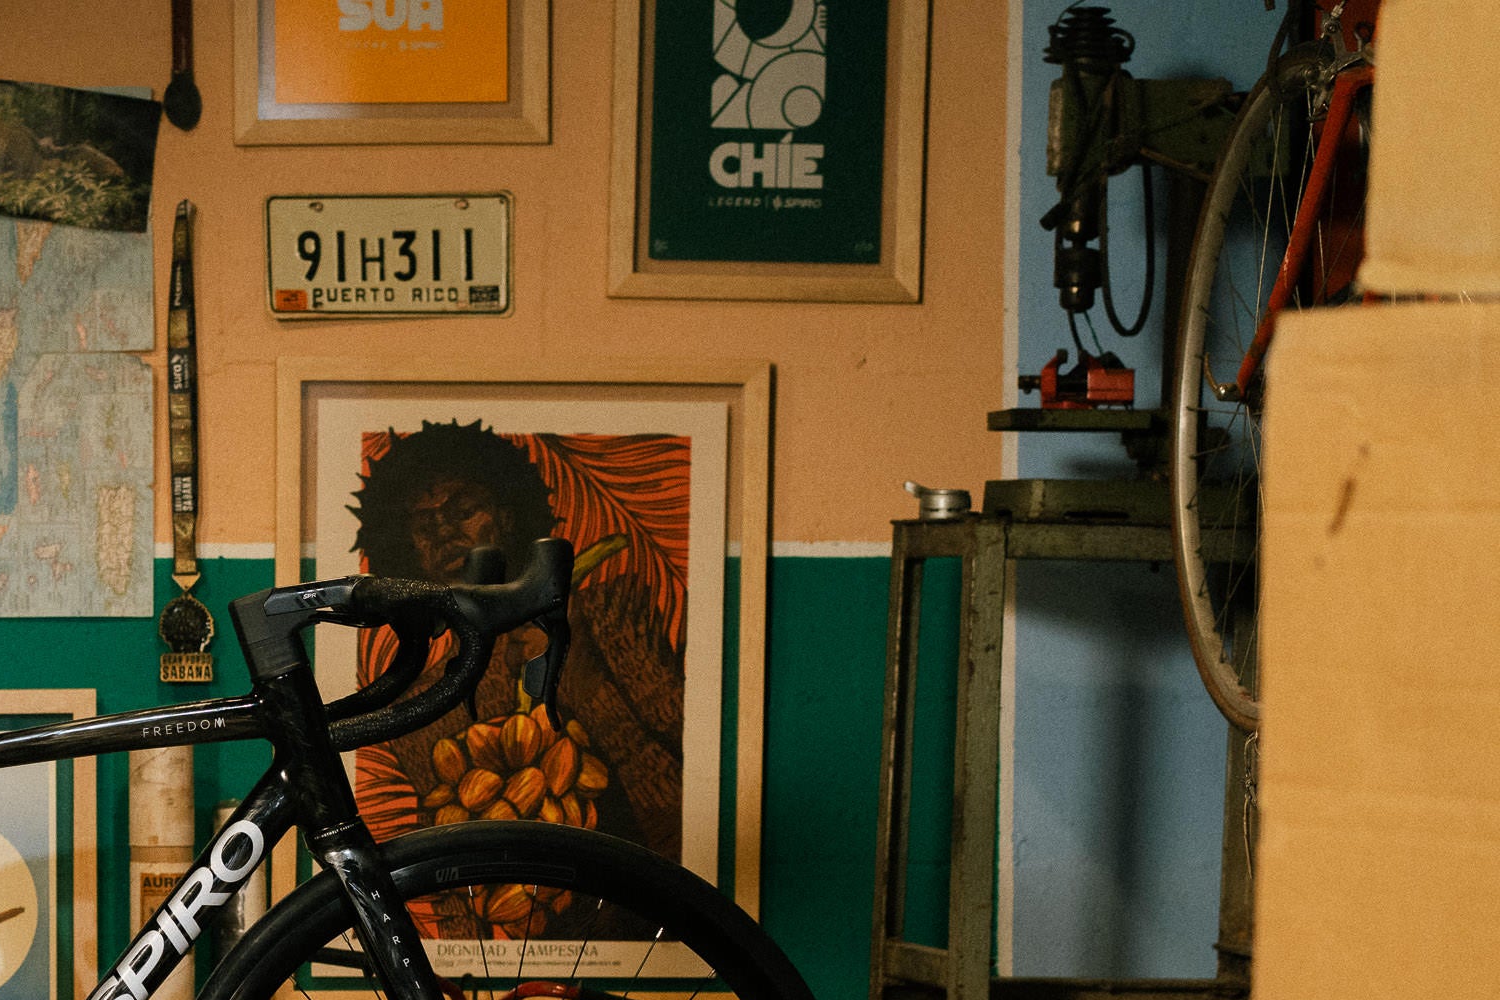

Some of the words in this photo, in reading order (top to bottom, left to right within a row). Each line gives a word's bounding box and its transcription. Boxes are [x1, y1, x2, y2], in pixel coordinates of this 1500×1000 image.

[709, 131, 824, 189] CHÍE
[708, 196, 760, 207] LEGEND
[297, 228, 473, 282] 91H311
[312, 287, 395, 303] PUERTO
[412, 287, 459, 302] RICO
[162, 665, 211, 680] SABANA
[142, 717, 226, 738] FREEDOM
[437, 944, 507, 957] DIGNIDAD
[516, 944, 599, 957] CAMPESINA
